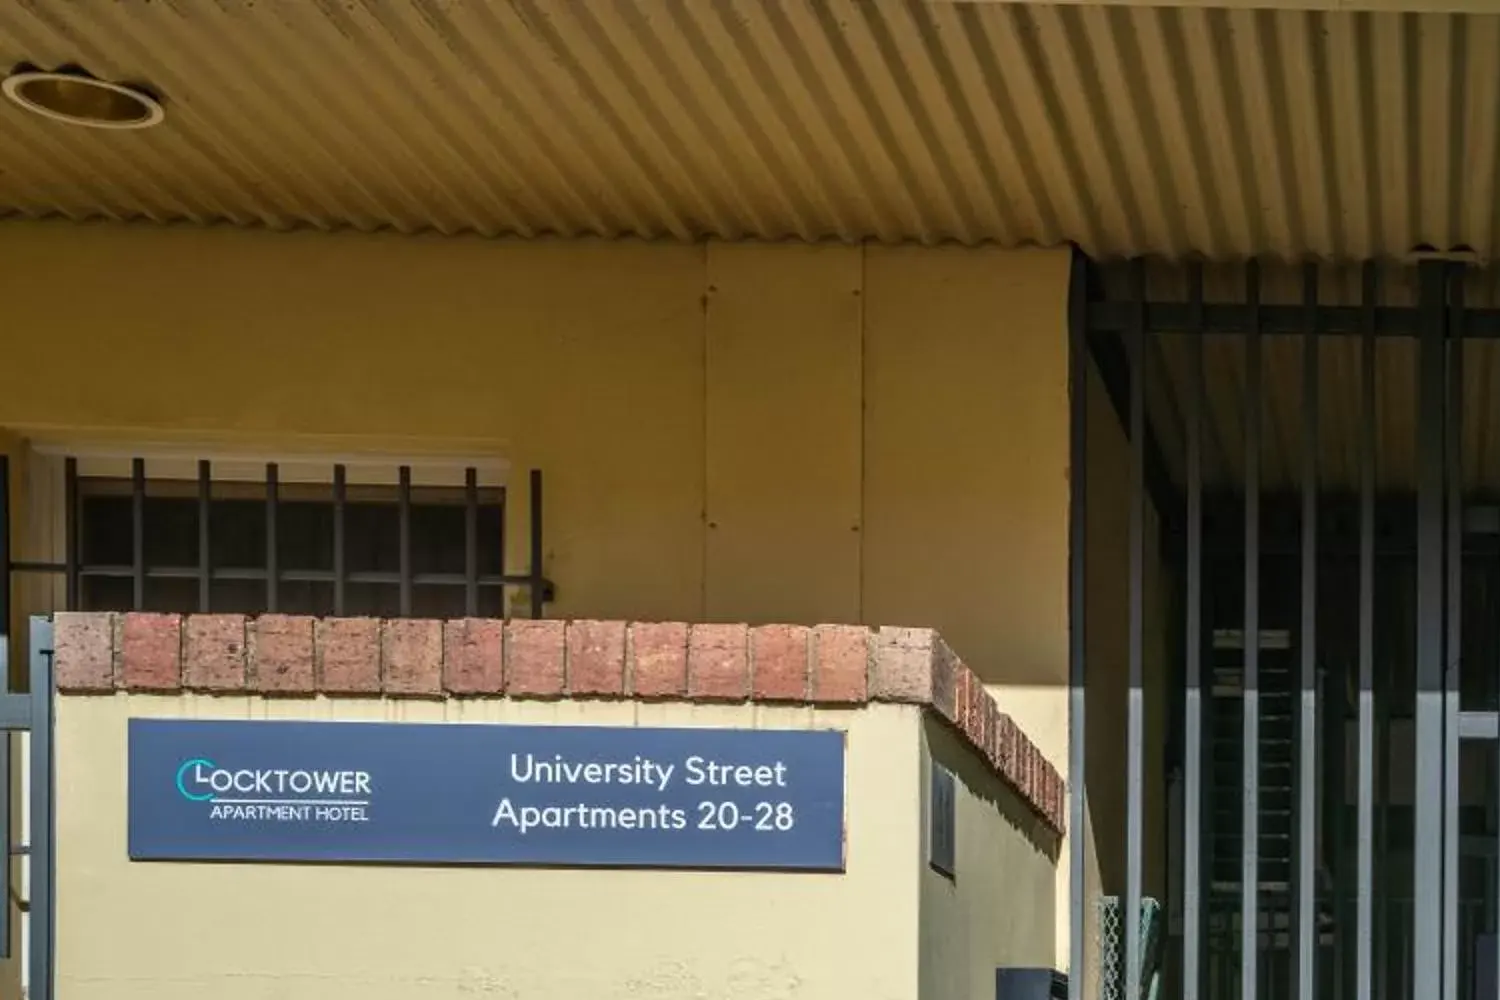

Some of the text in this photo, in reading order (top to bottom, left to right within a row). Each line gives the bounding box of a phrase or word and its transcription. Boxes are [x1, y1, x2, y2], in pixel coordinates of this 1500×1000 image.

[194, 763, 372, 794] LOCKTOWER
[510, 753, 788, 791] University Street
[209, 804, 369, 821] APARTMENT HOTEL
[491, 797, 795, 835] Apartments 20-28
